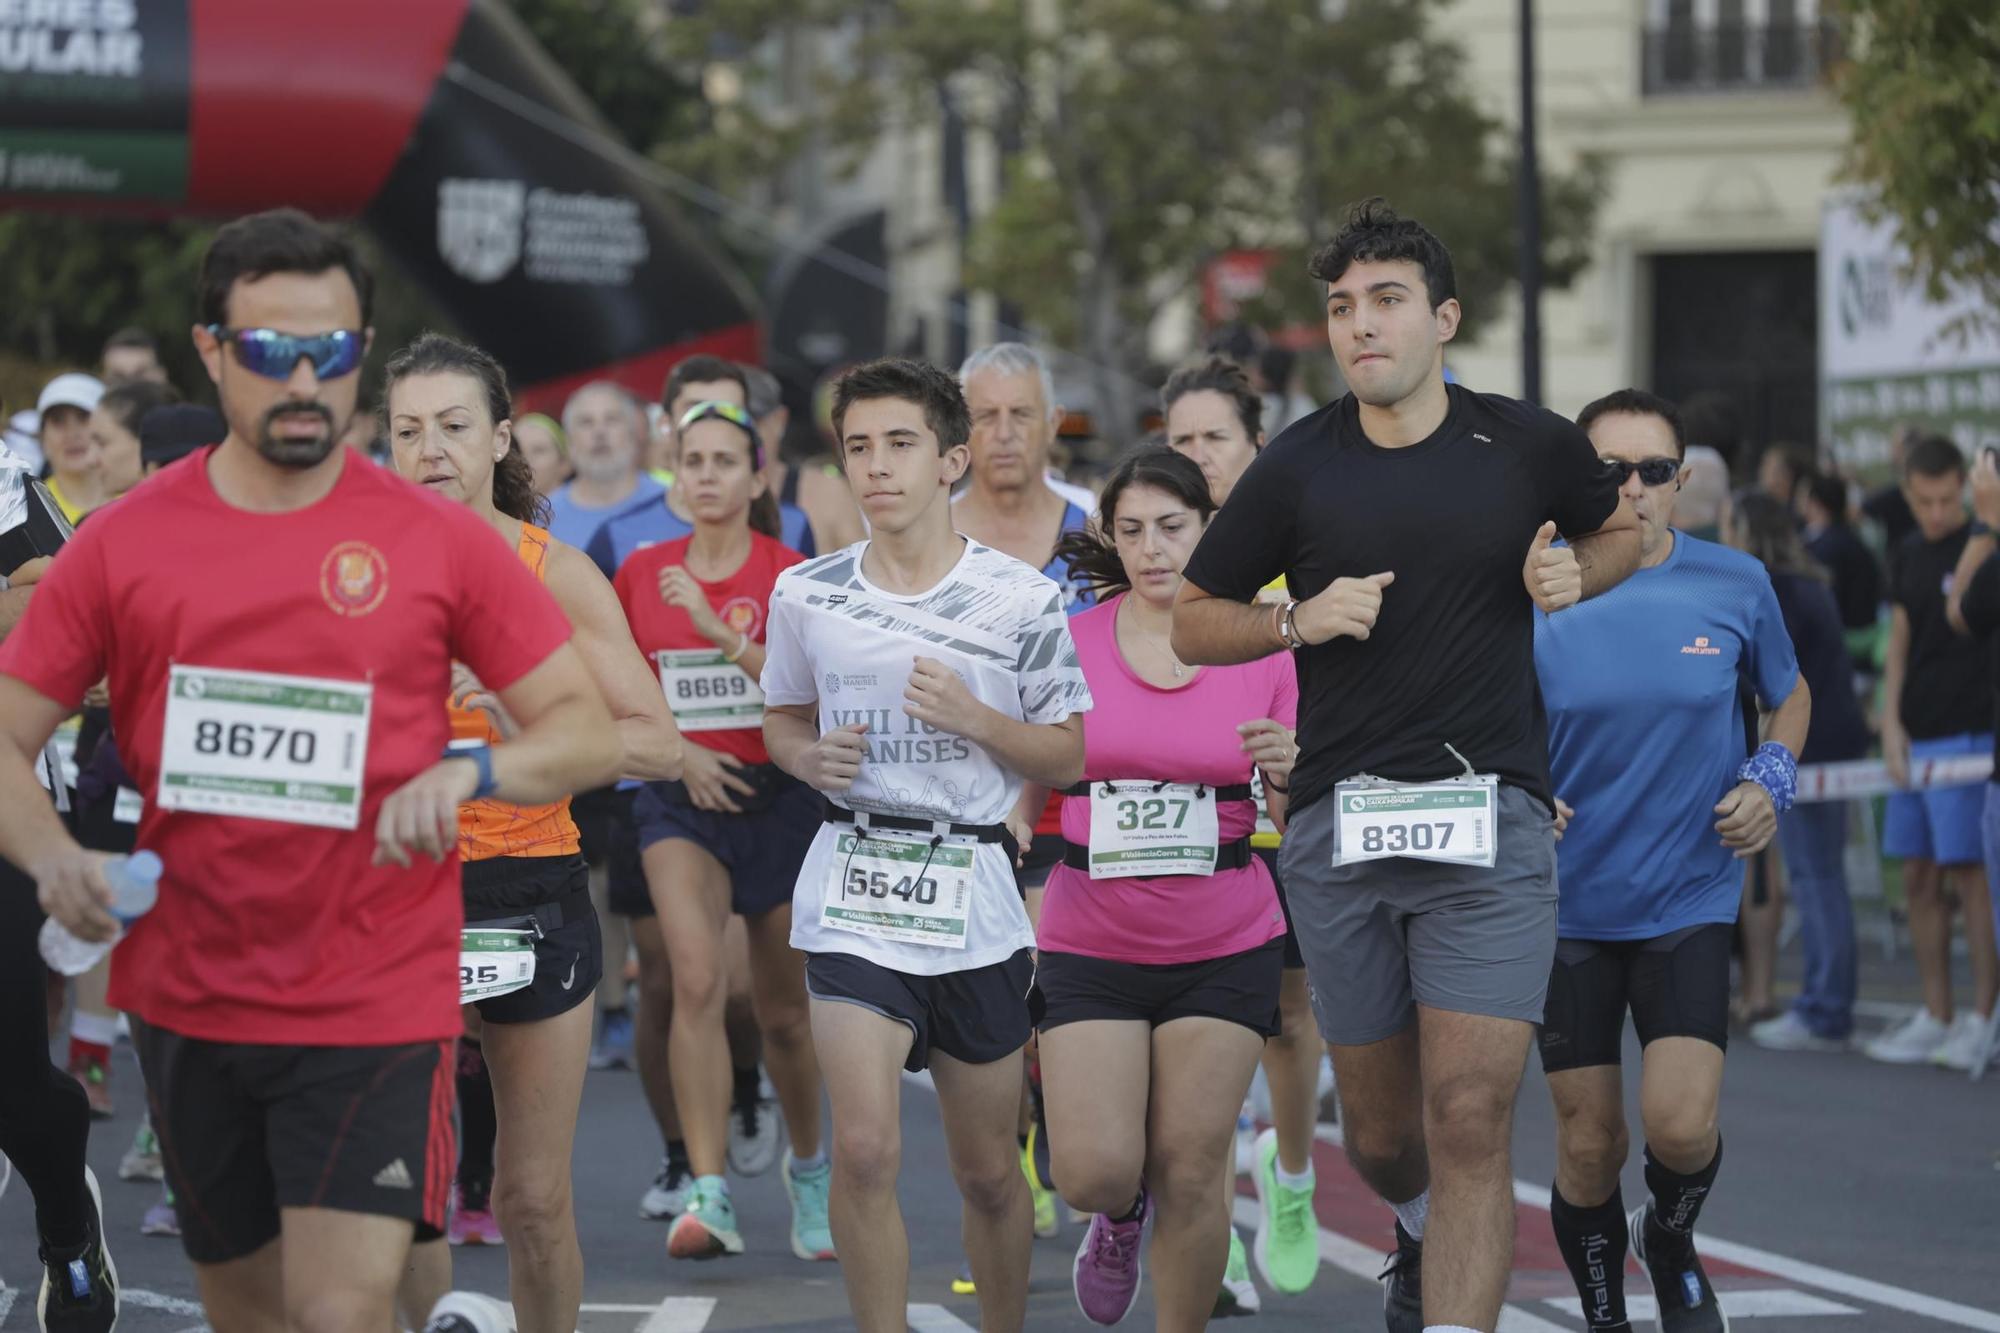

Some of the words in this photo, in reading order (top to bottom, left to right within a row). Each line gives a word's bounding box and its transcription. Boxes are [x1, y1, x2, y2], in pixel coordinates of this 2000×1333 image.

[677, 676, 746, 699] 8669
[194, 720, 316, 764] 8670
[1117, 799, 1190, 830] 327
[1362, 822, 1455, 852] 8307
[847, 868, 938, 905] 5540
[1581, 1233, 1612, 1322] kalenji
